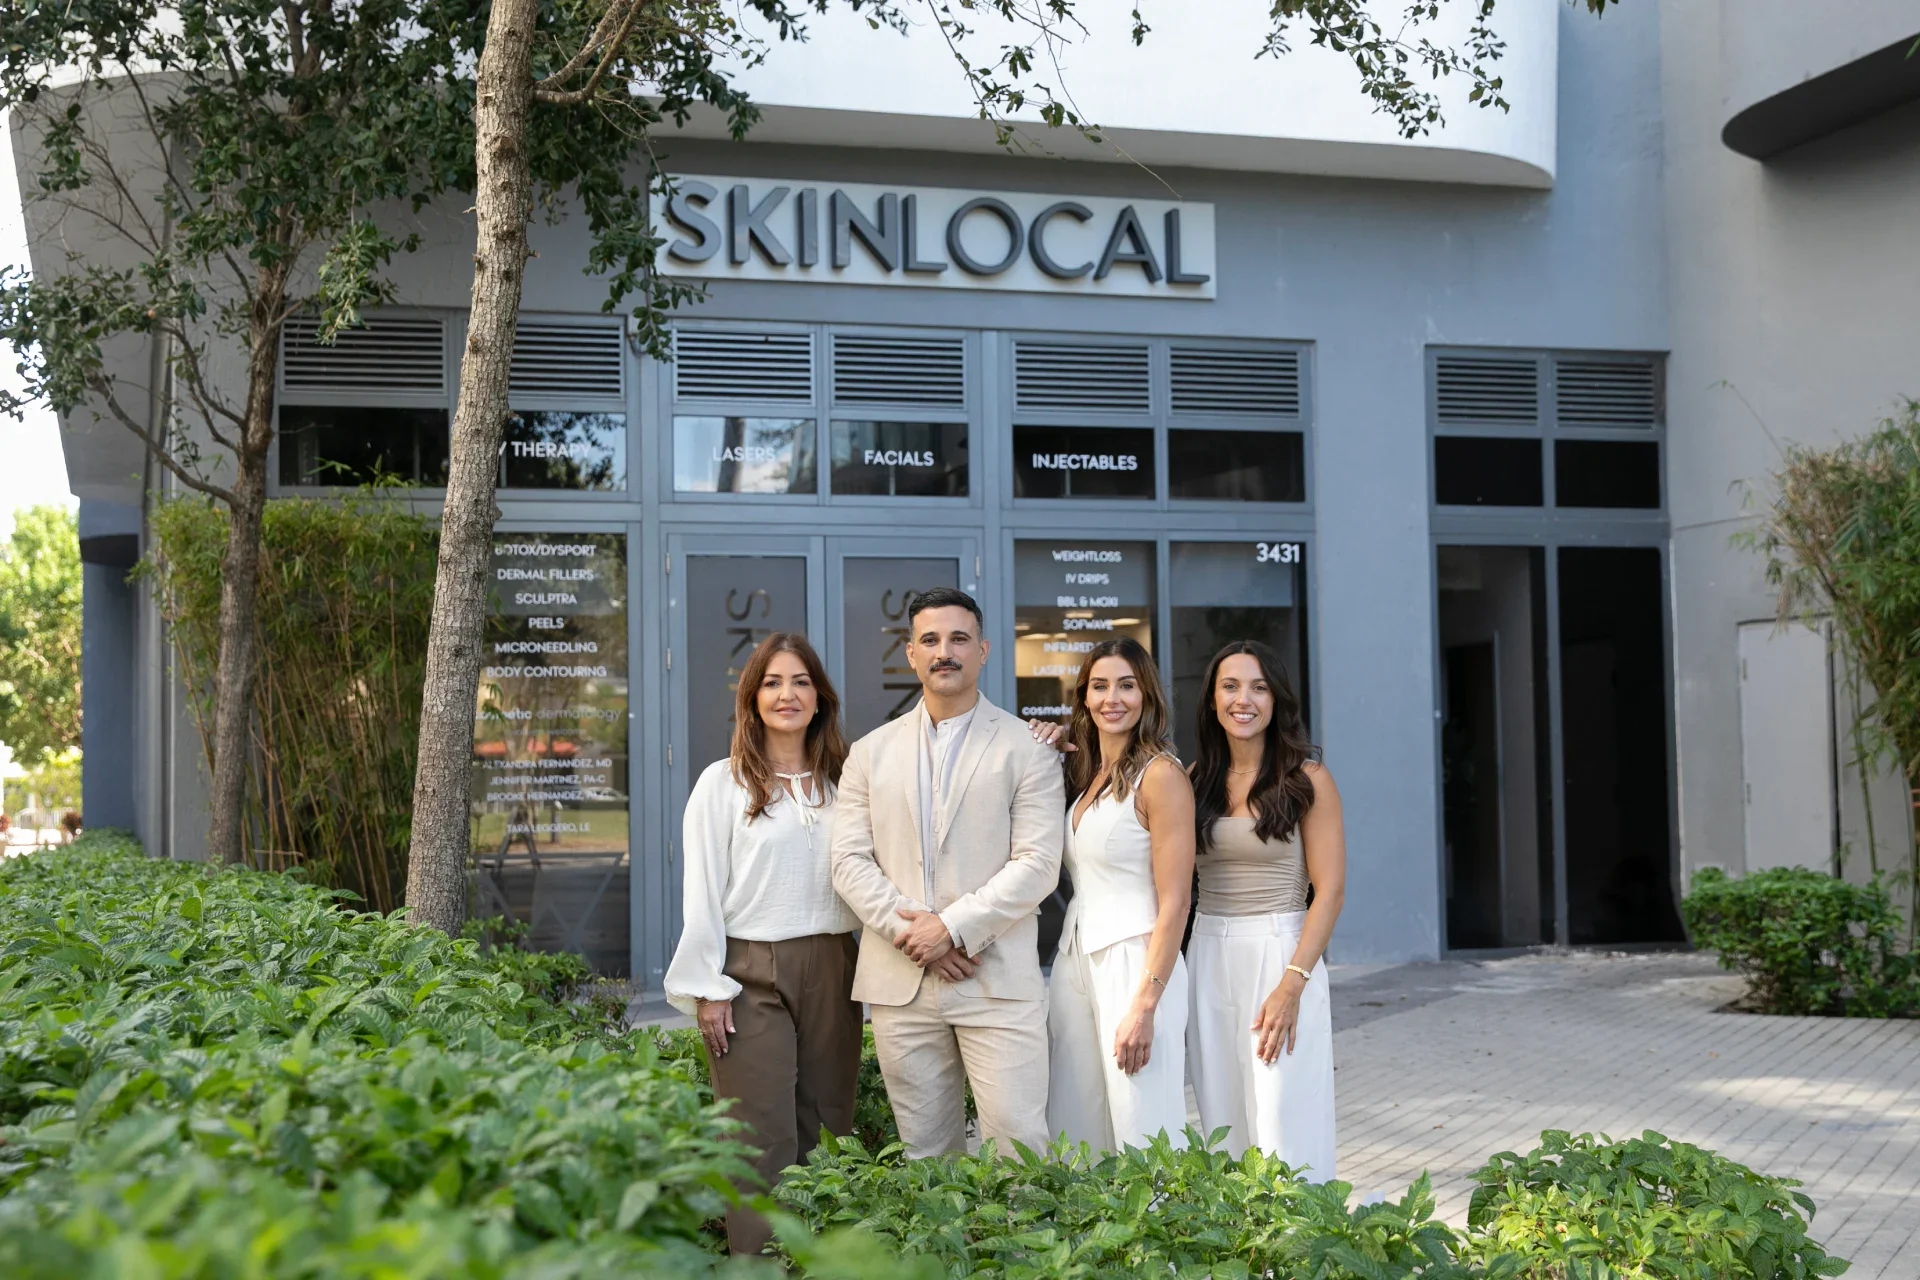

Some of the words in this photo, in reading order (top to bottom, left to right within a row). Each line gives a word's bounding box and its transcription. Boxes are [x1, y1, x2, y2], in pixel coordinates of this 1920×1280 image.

[667, 180, 1211, 287] SKINLOCAL
[510, 441, 592, 457] THERAPY
[712, 446, 776, 462] LASERS
[864, 449, 934, 468] FACIALS
[1032, 453, 1138, 471] INJECTABLES
[1052, 550, 1122, 563] WEIGHTLOSS
[1256, 542, 1300, 564] 3431
[497, 569, 546, 580] DERMAL
[549, 569, 595, 580] FILLERS
[1065, 573, 1077, 584] IV
[1078, 573, 1110, 585] DRIPS
[515, 593, 577, 605] SCULPTRA
[528, 617, 564, 629] PEELS
[495, 642, 598, 653] MICRONEEDLING
[486, 666, 521, 677] BODY
[524, 666, 607, 677] CONTOURING
[1032, 665, 1066, 676] LASER
[536, 707, 622, 722] dermatology
[596, 758, 612, 768] MD
